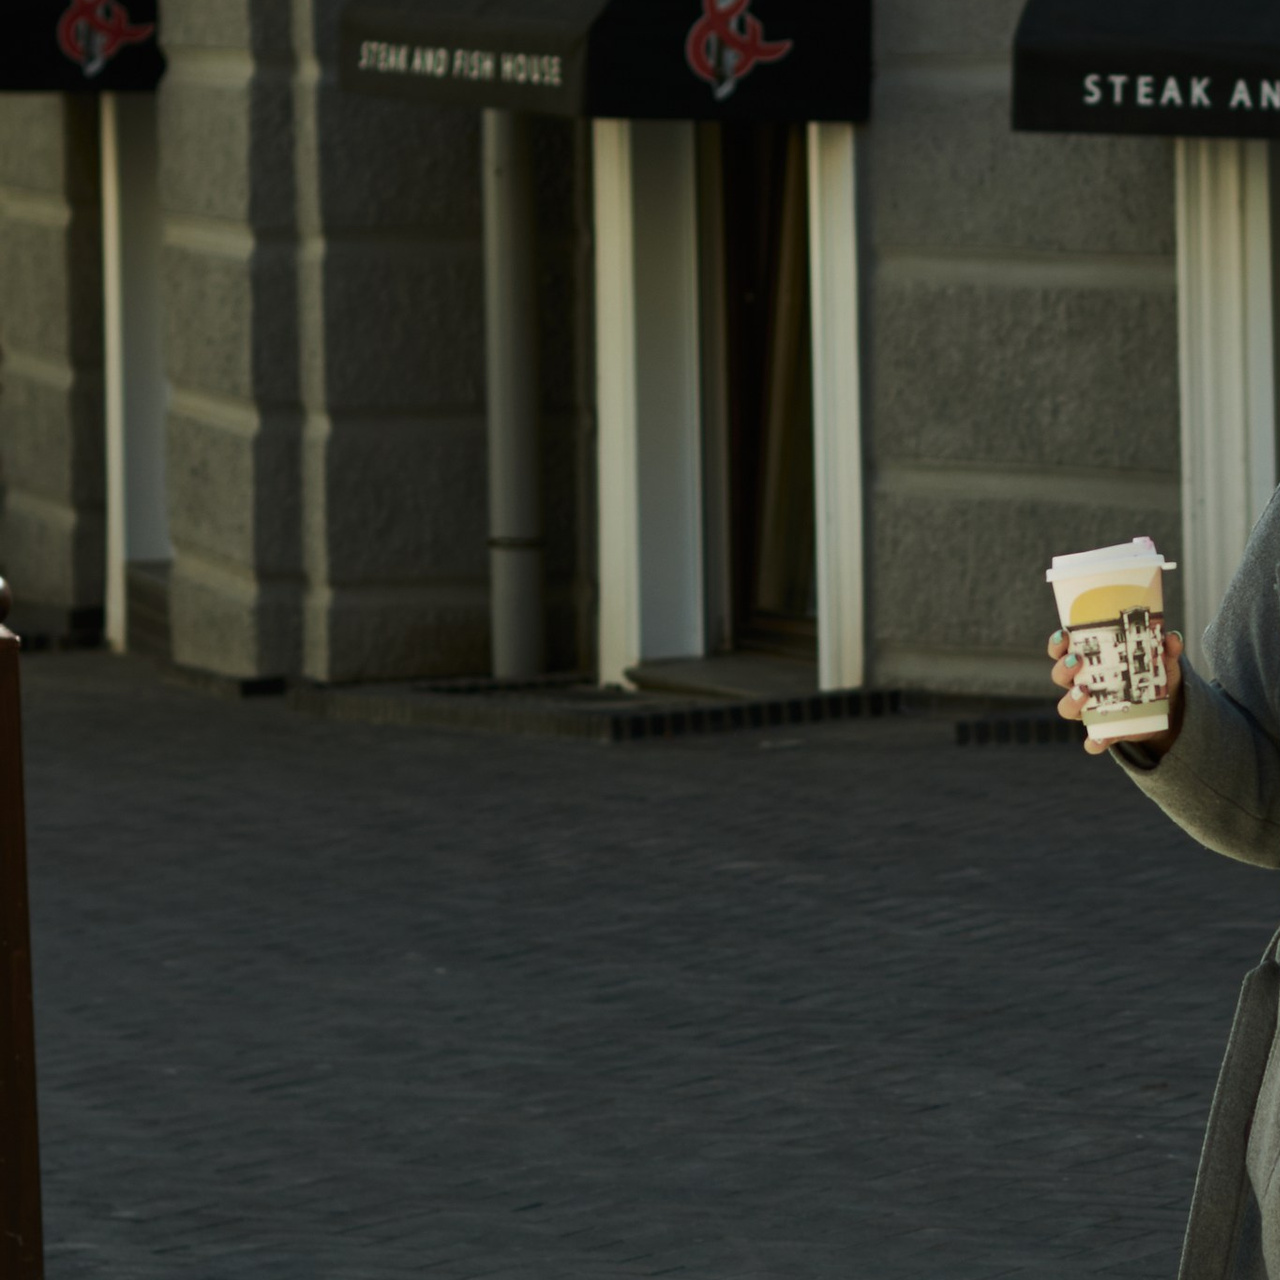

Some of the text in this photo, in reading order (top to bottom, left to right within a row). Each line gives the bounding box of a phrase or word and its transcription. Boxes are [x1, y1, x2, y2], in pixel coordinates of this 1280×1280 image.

[358, 40, 562, 87] STEAK AND FISH HOUSE
[1083, 74, 1212, 107] STEAK
